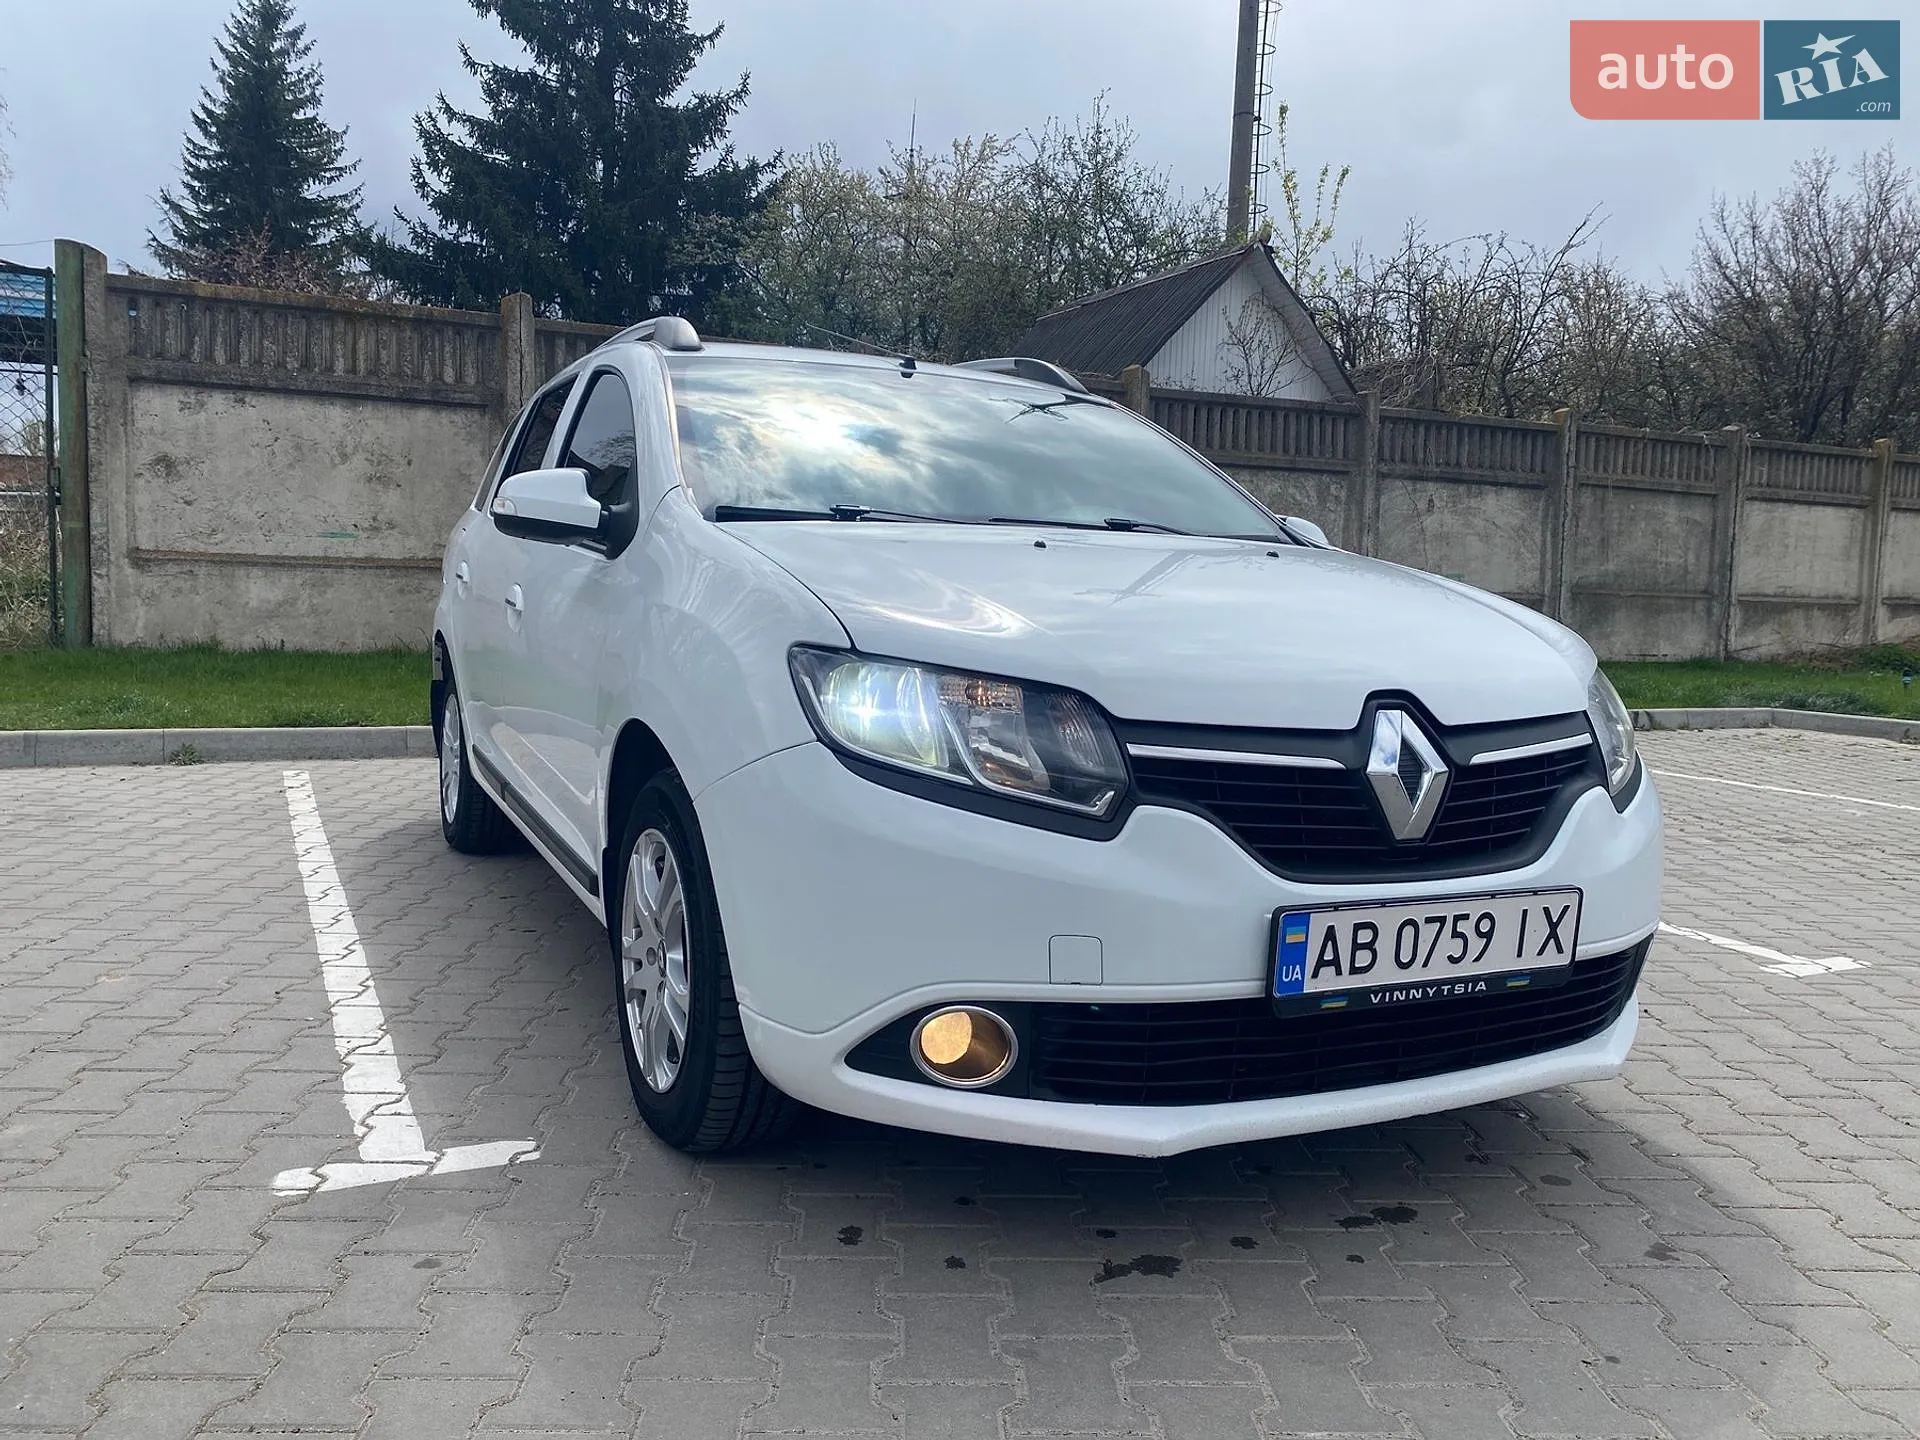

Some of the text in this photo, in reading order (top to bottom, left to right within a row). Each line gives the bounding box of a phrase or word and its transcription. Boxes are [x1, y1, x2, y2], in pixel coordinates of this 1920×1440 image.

[1311, 904, 1571, 979] AB 0759 IX
[1282, 964, 1303, 982] UA
[1369, 981, 1487, 1004] VINNYTSIA
